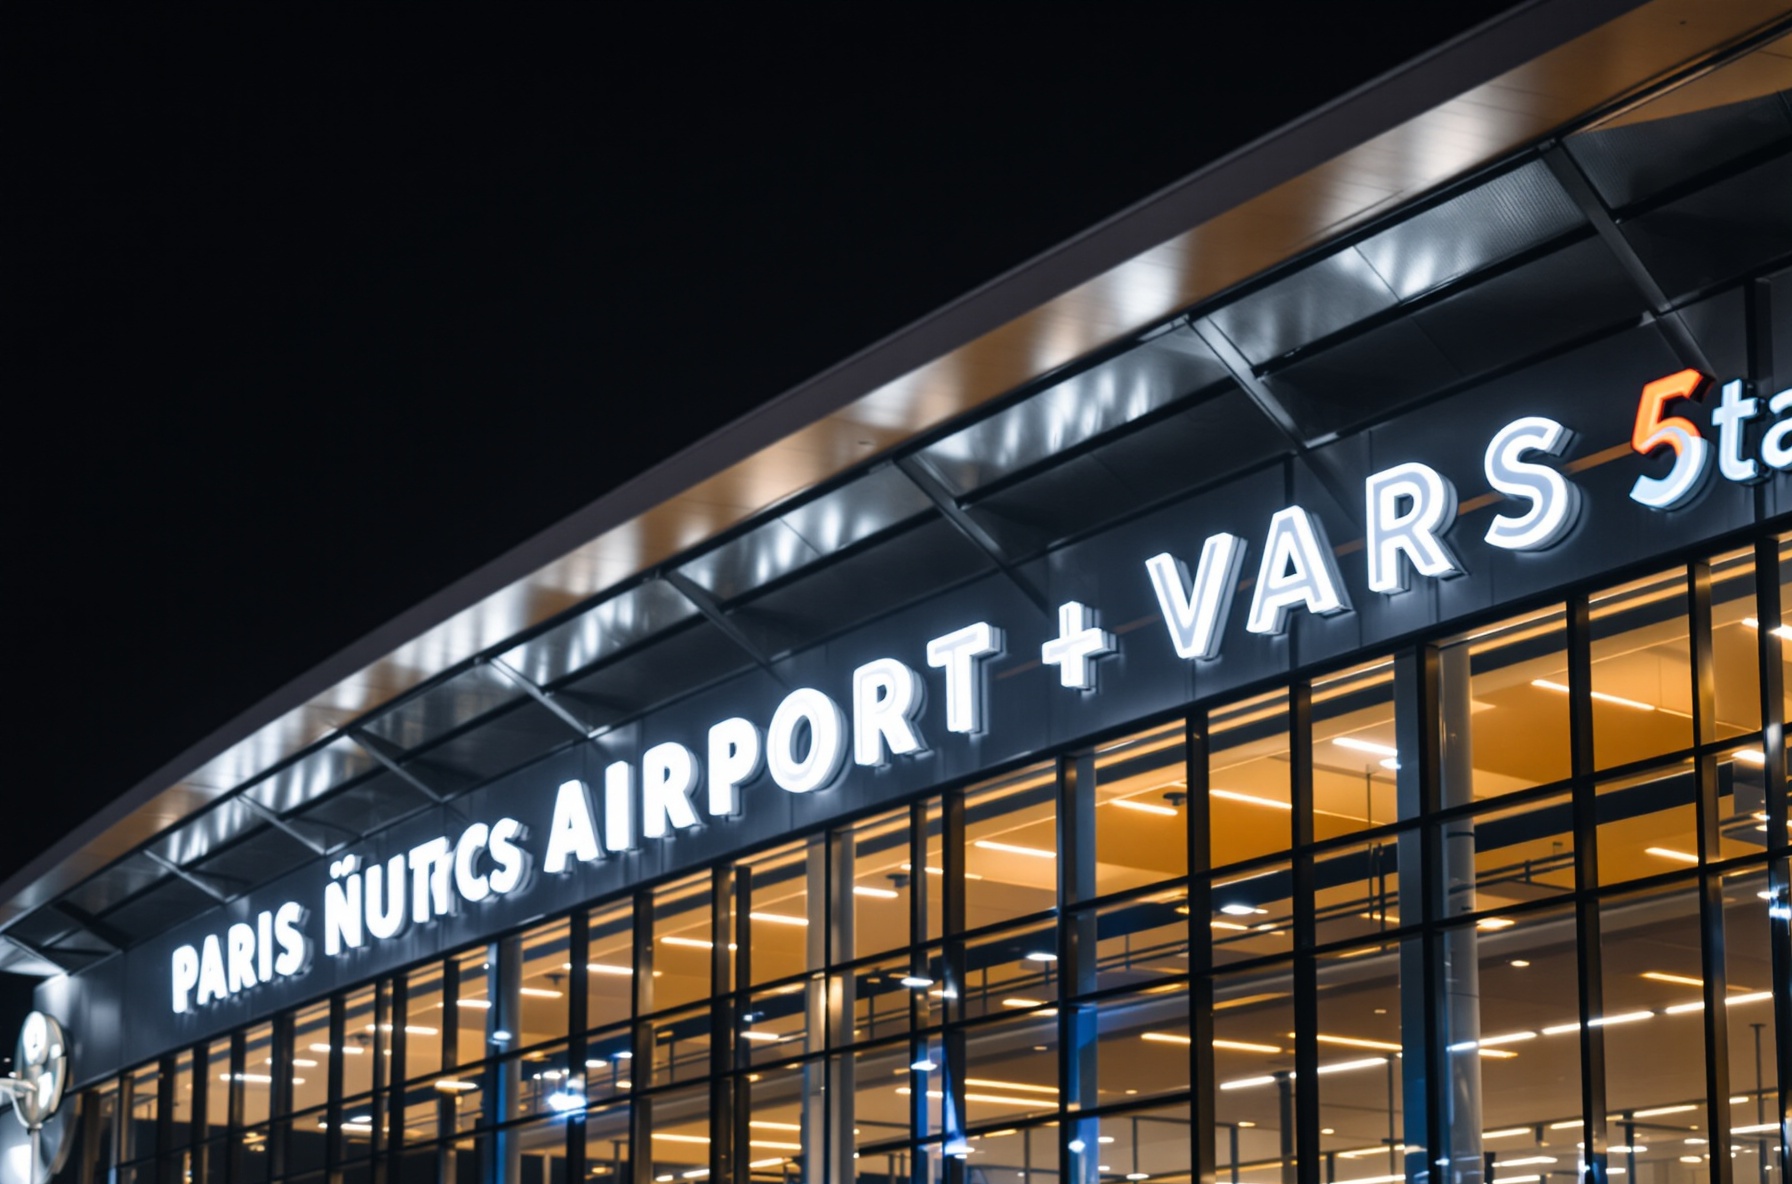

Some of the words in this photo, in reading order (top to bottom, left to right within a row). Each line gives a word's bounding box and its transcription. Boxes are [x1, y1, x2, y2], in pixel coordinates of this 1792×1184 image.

[171, 901, 308, 1013] PARIS
[543, 621, 1002, 874] AIRPORT
[1145, 415, 1578, 660] VARS
